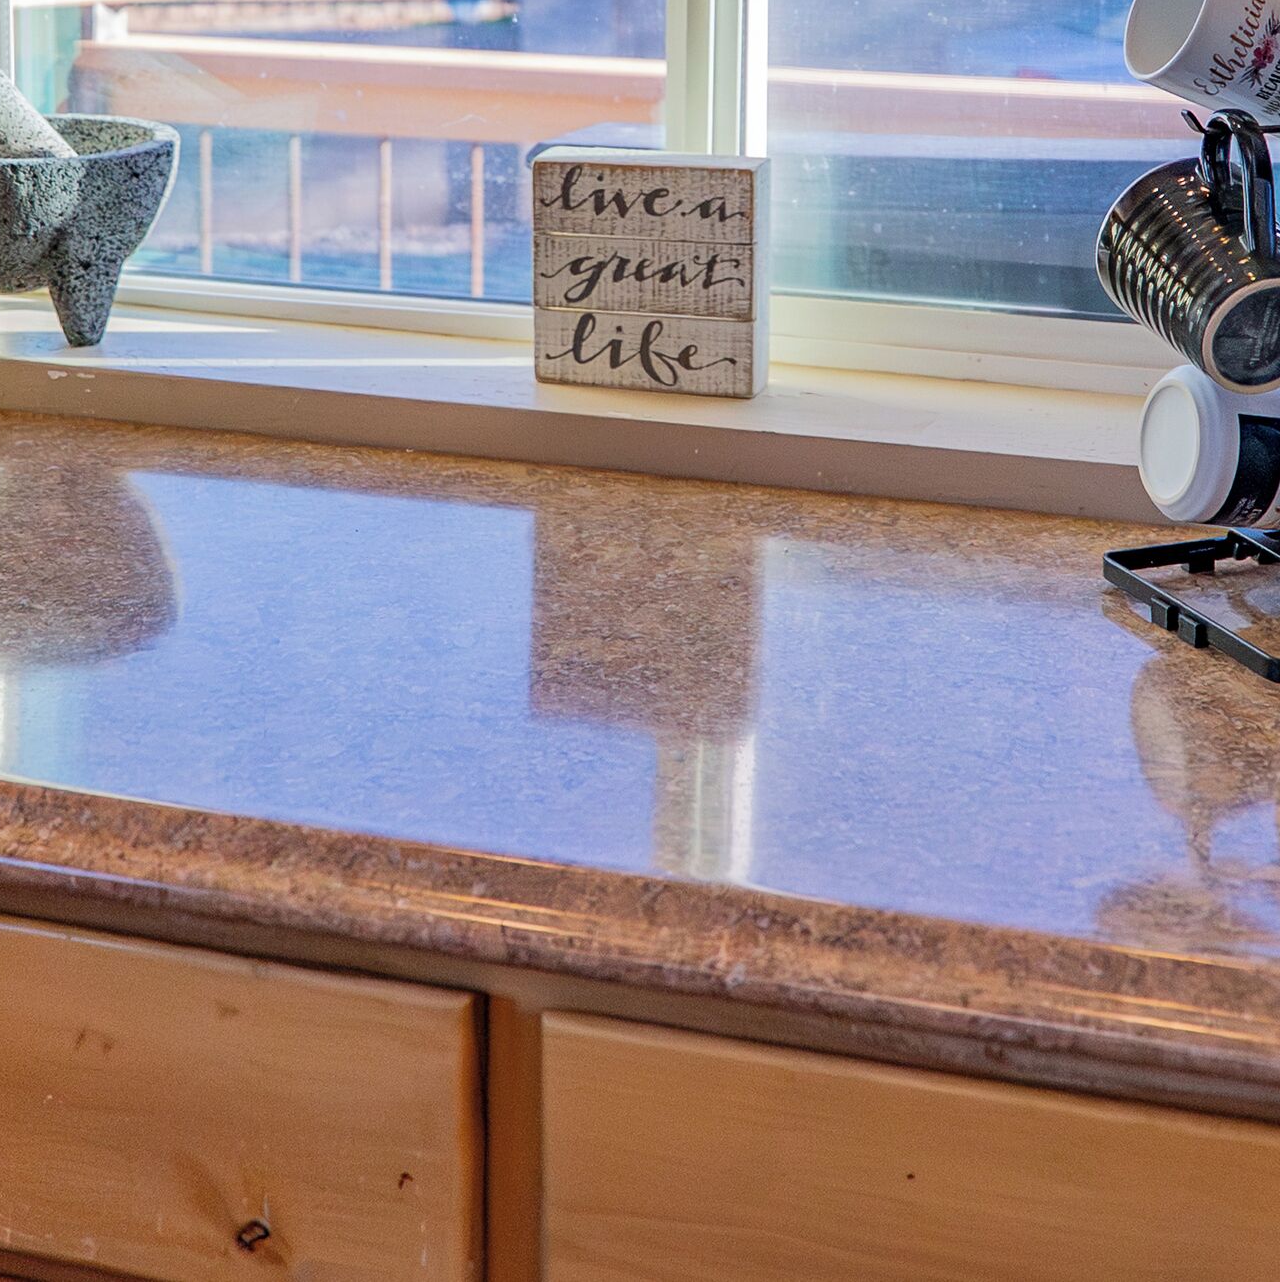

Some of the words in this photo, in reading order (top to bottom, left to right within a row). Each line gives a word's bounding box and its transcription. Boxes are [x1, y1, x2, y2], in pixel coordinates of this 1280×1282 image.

[540, 164, 682, 218] live
[681, 196, 749, 222] a
[540, 251, 745, 303] great
[545, 312, 737, 386] life
